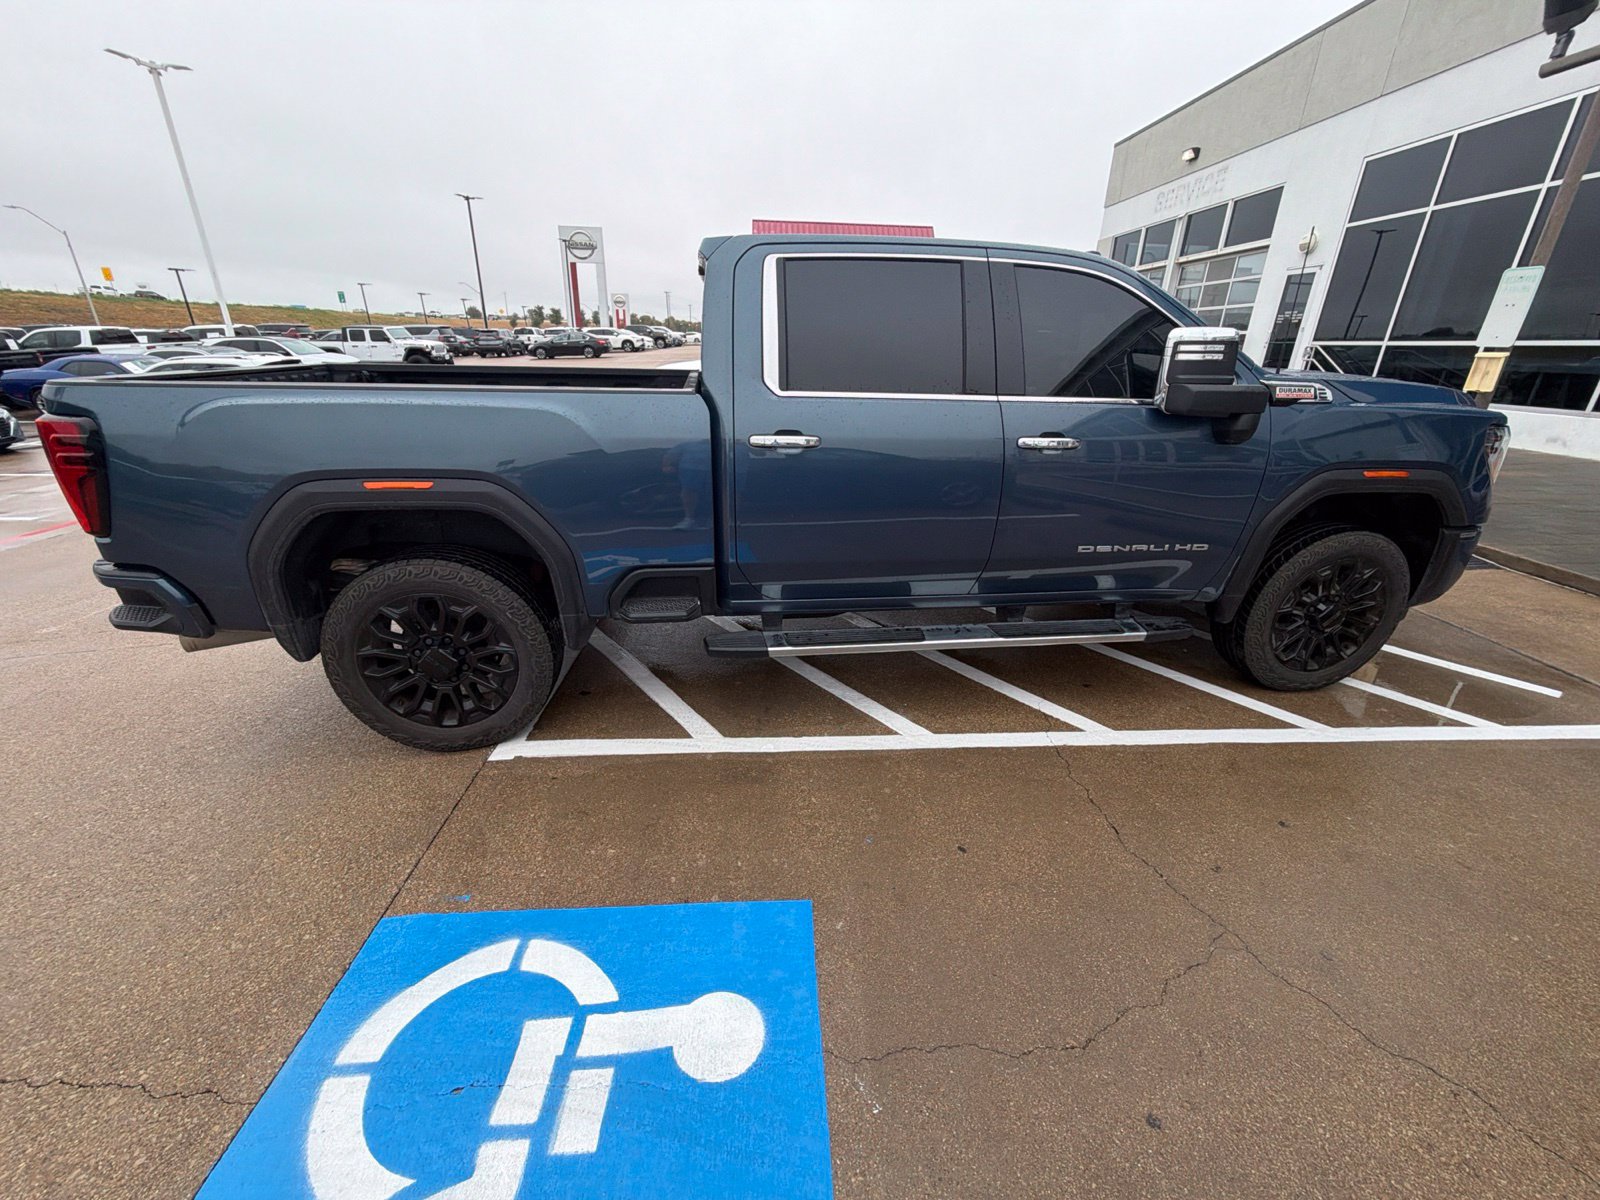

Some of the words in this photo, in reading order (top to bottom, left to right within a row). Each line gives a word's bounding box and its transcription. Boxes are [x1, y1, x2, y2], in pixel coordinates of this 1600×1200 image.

[1155, 166, 1229, 213] SERVICE
[1077, 544, 1170, 553] DENALI
[1174, 543, 1209, 551] HD
